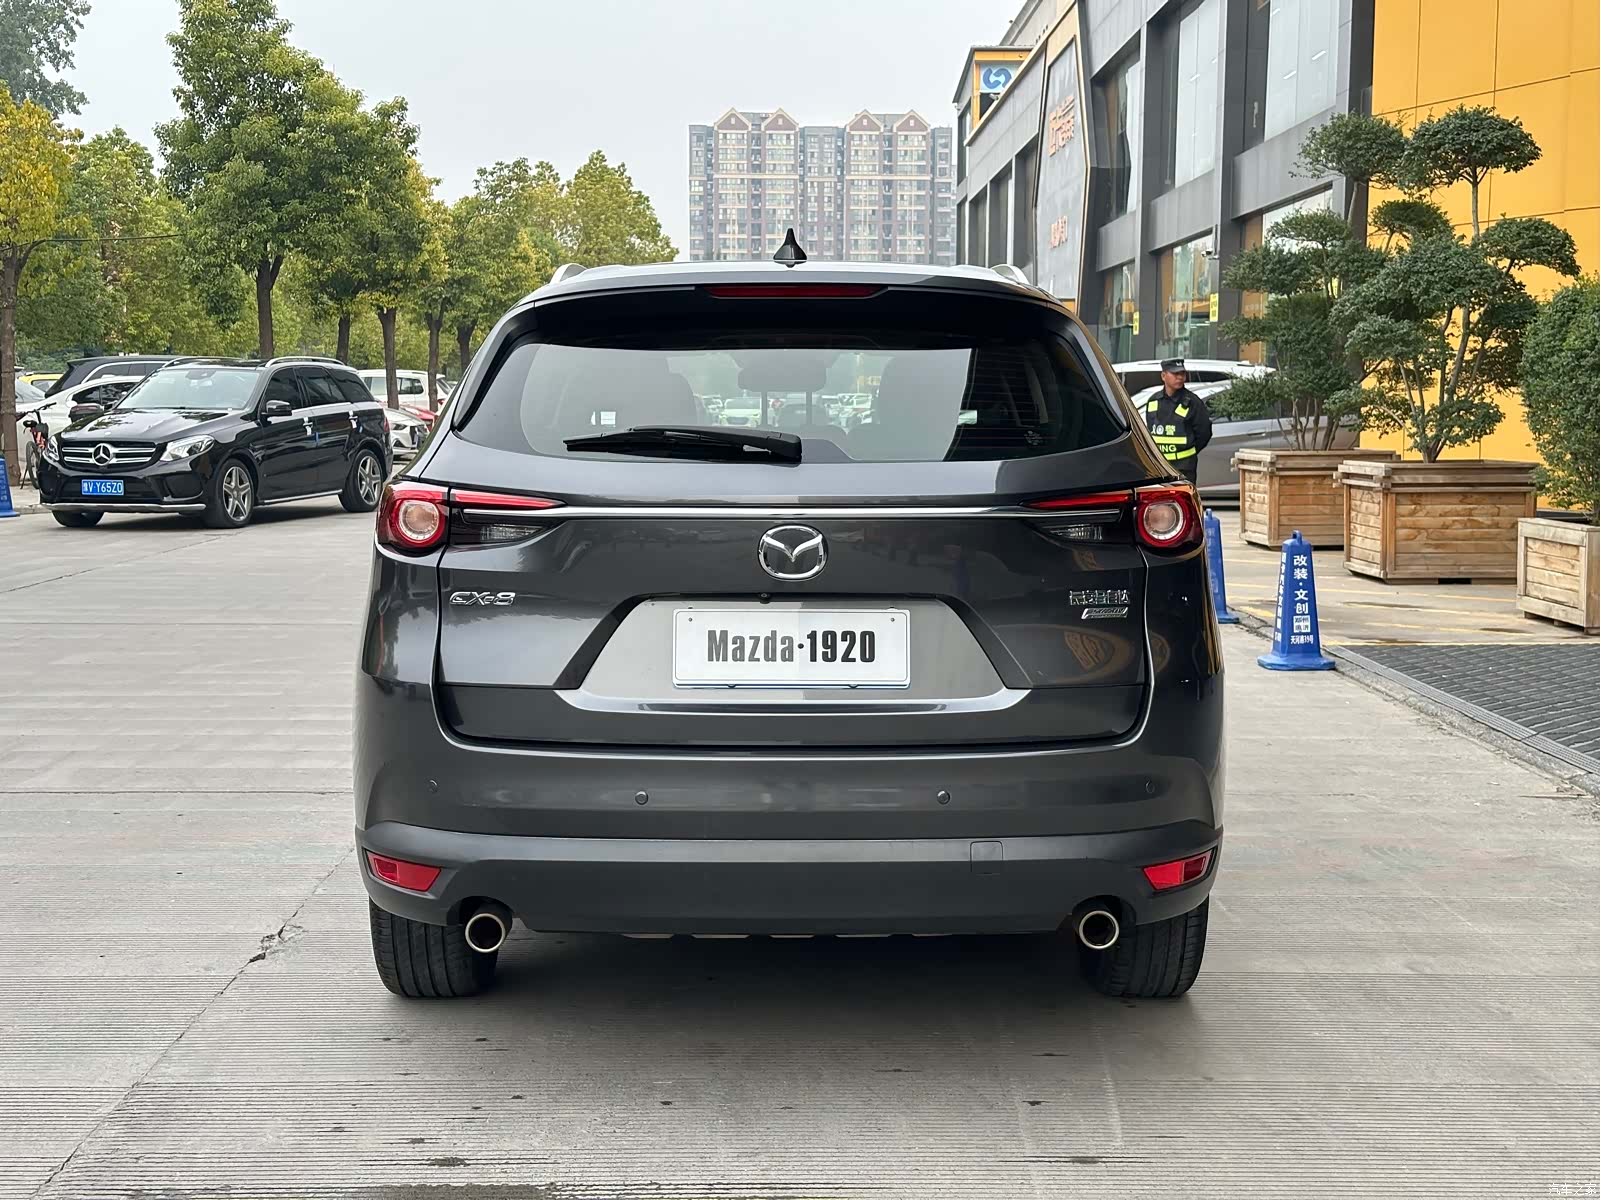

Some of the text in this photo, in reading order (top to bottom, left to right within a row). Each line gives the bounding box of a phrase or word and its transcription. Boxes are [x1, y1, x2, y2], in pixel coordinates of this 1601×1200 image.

[449, 590, 516, 606] CX-8
[1293, 555, 1309, 614] 改装·文创
